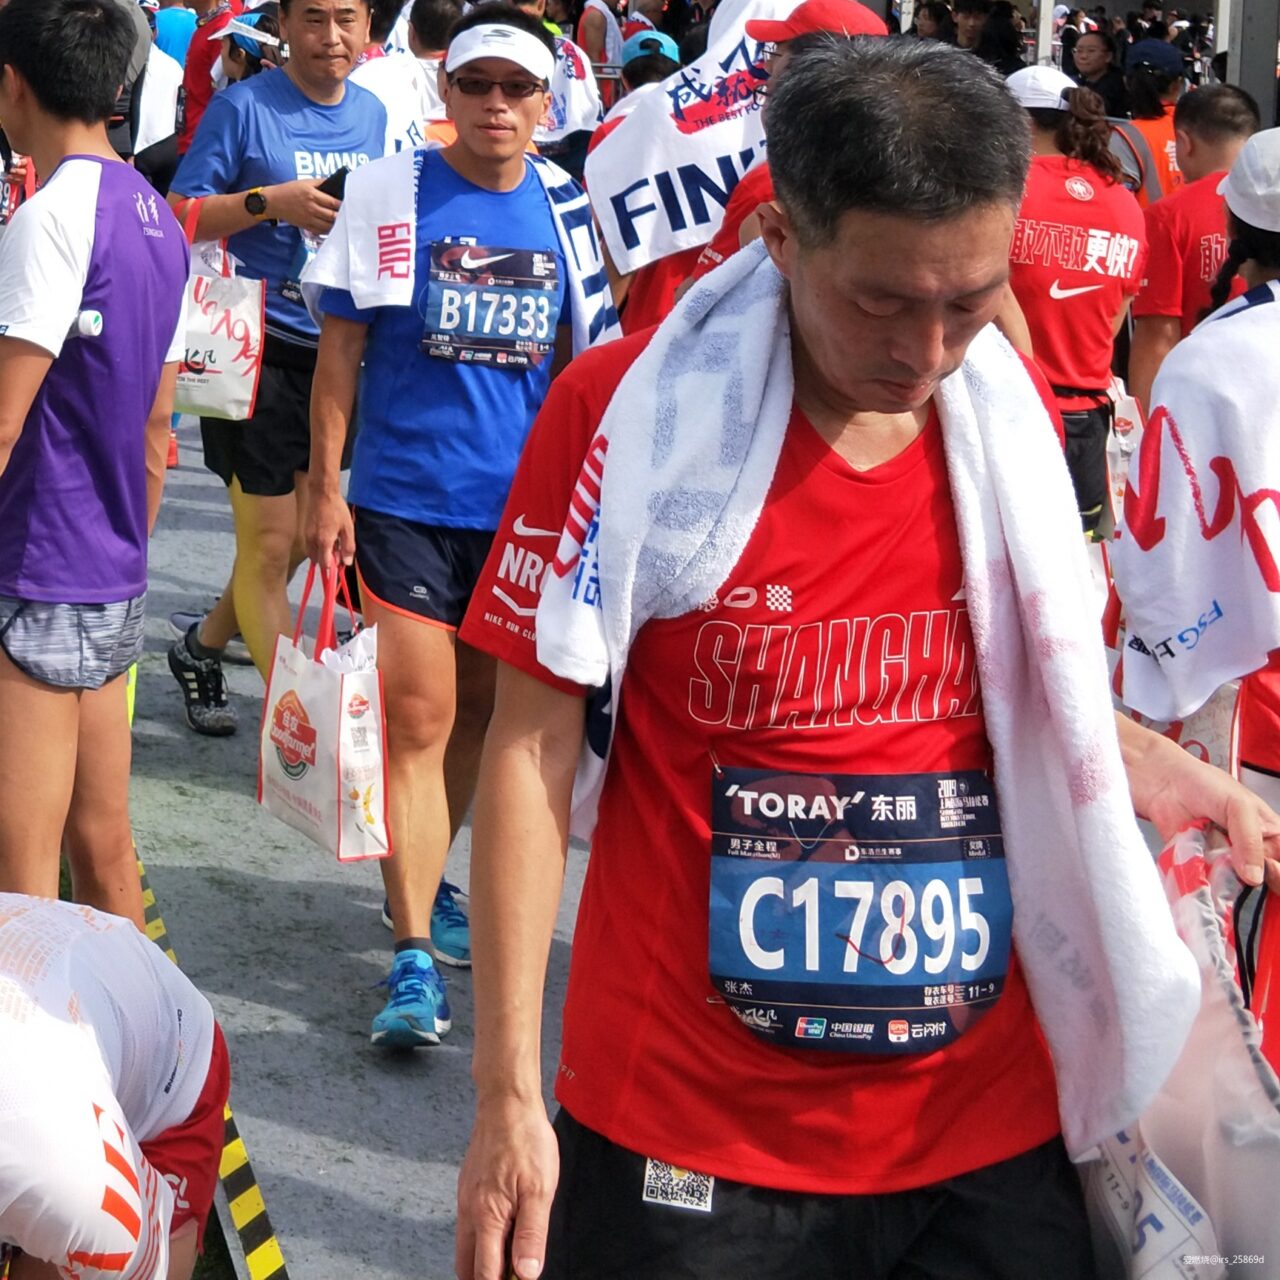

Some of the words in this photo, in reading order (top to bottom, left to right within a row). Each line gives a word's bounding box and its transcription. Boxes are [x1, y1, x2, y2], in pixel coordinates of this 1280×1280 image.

[694, 116, 715, 128] THE
[718, 108, 745, 122] BEST
[1009, 218, 1139, 279] 敢不敢更快?
[439, 288, 550, 339] B17333
[484, 612, 503, 627] NIKE
[505, 620, 520, 633] RUN
[688, 608, 980, 731] SHANGHA
[937, 779, 957, 798] 2019
[870, 794, 917, 821] 东丽
[730, 838, 777, 852] 男子全程
[739, 876, 990, 975] C17895
[724, 980, 753, 996] 张杰
[968, 983, 995, 999] 11-9
[830, 1022, 875, 1034] 中国银联
[911, 1021, 946, 1038] 云闪付
